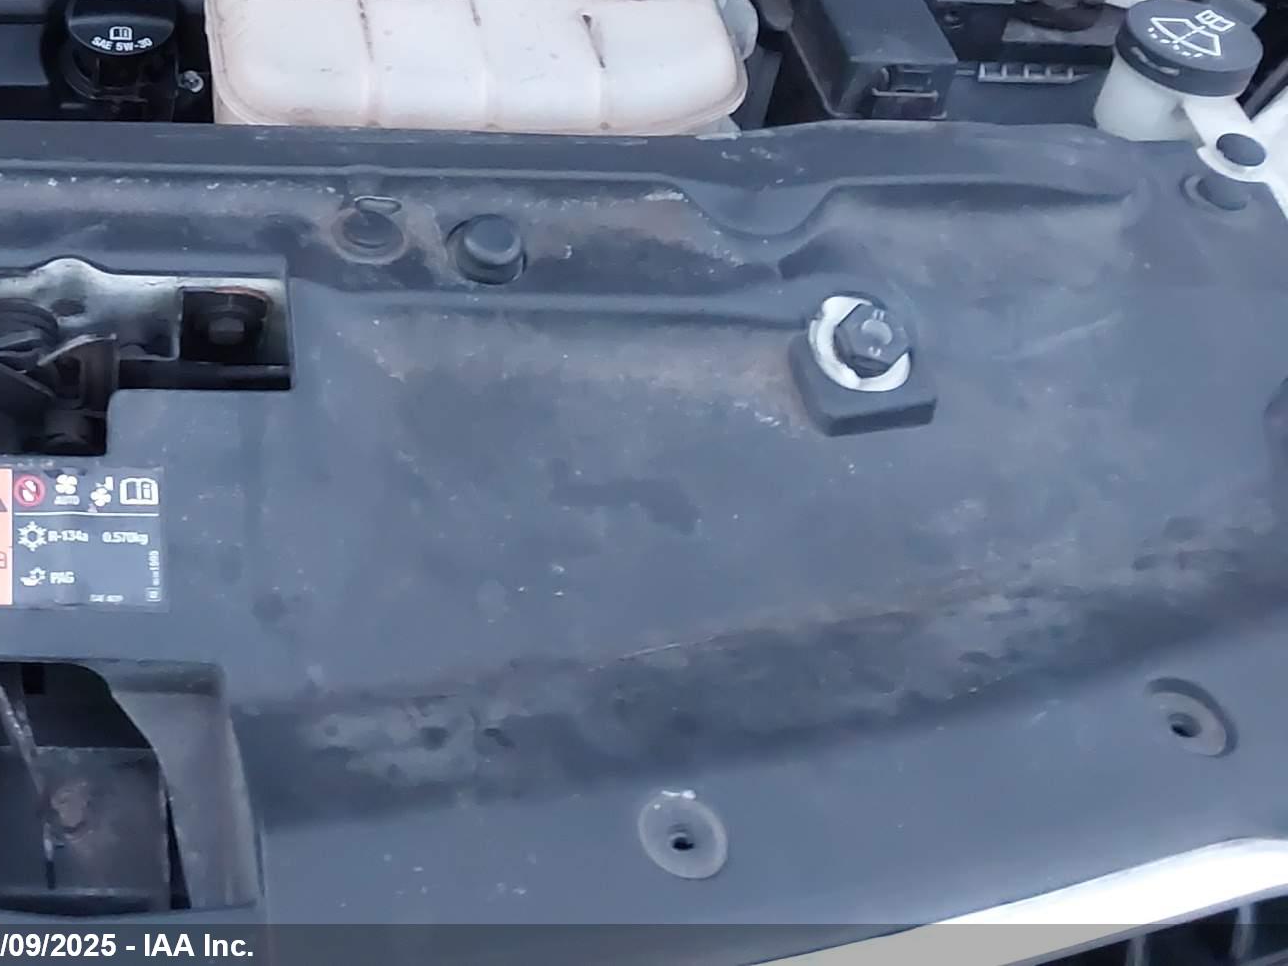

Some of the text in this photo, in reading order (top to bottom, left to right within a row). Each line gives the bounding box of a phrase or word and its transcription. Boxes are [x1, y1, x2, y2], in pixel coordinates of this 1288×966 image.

[91, 36, 153, 52] SAE 5W-30
[47, 530, 89, 543] R-134a
[49, 571, 76, 585] PAG
